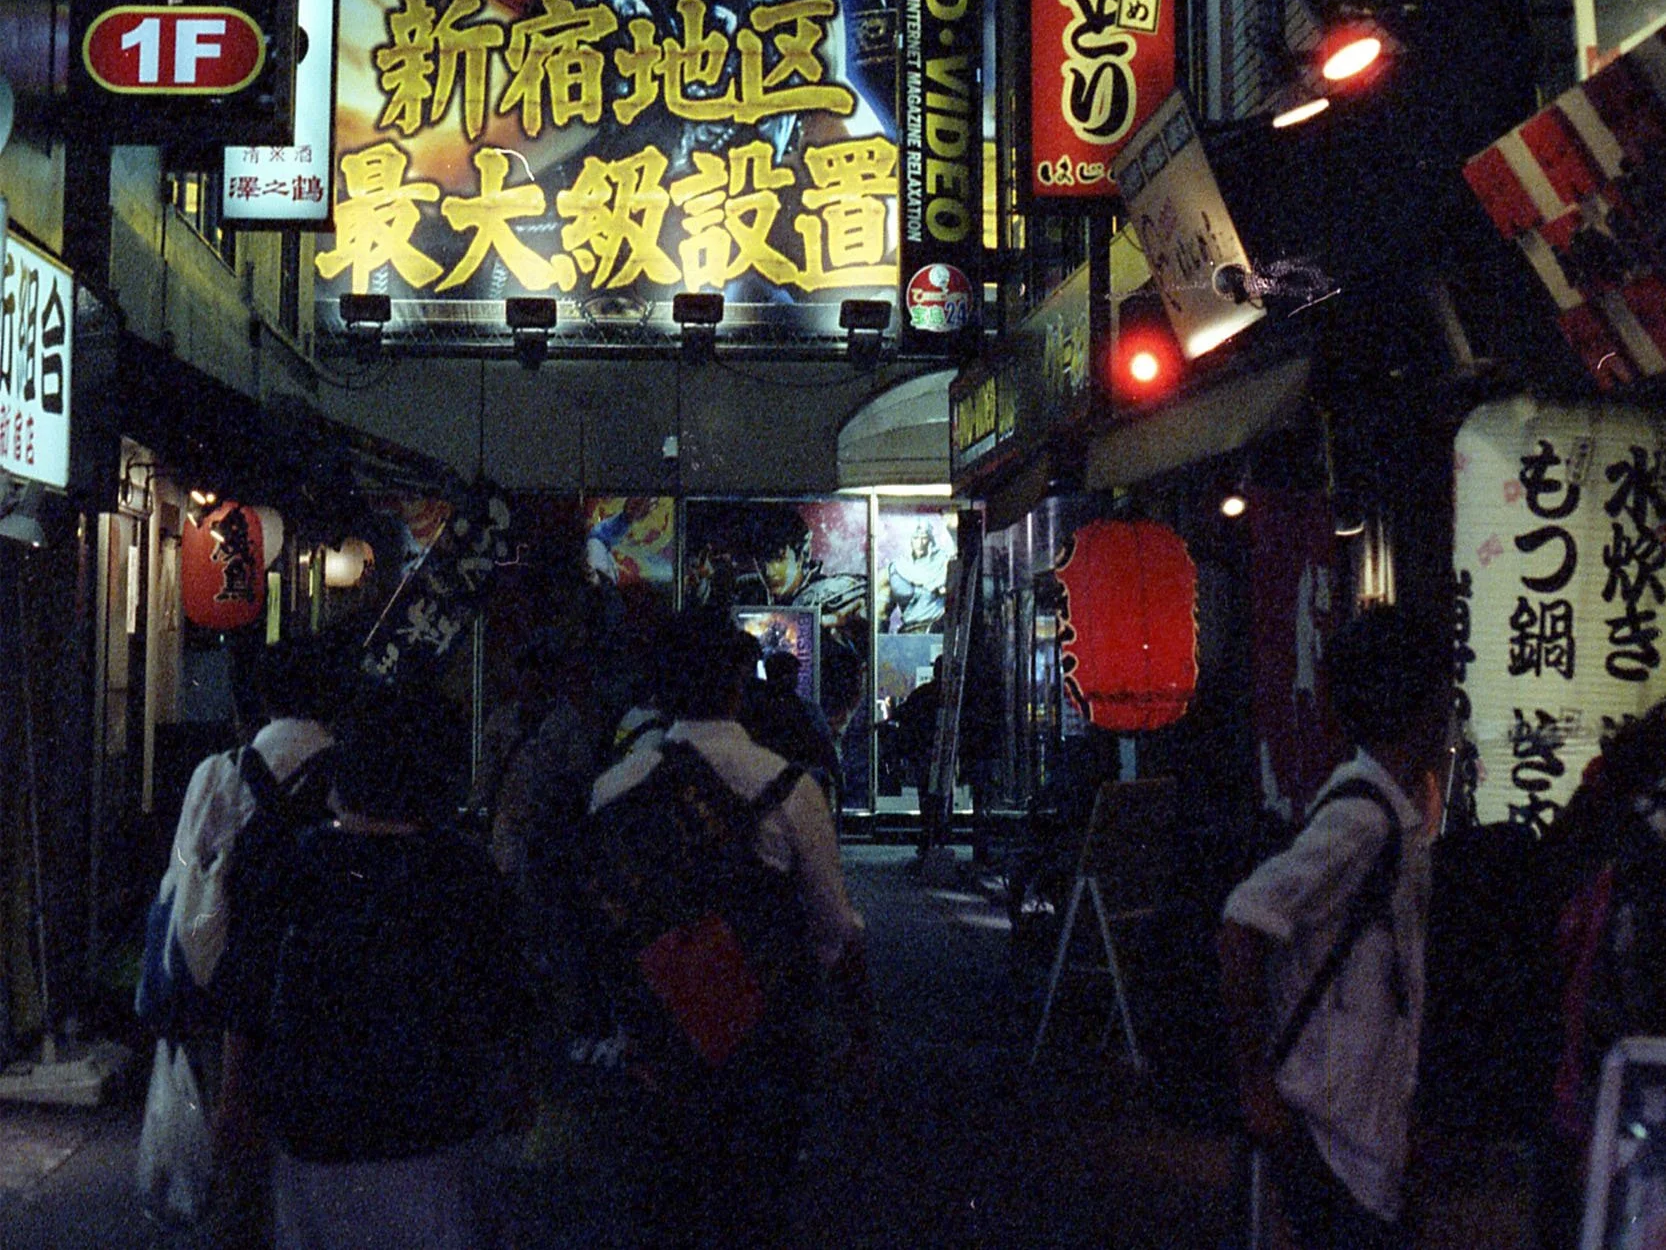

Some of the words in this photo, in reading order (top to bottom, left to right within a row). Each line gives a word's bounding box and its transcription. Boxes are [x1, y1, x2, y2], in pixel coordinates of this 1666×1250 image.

[121, 18, 227, 84] 1F
[906, 73, 922, 148] MAGAZINE
[906, 152, 922, 242] RELAXATION
[1038, 155, 1117, 187] はじ
[315, 143, 898, 294] 最大級設置
[1510, 440, 1580, 680] もつ鍋
